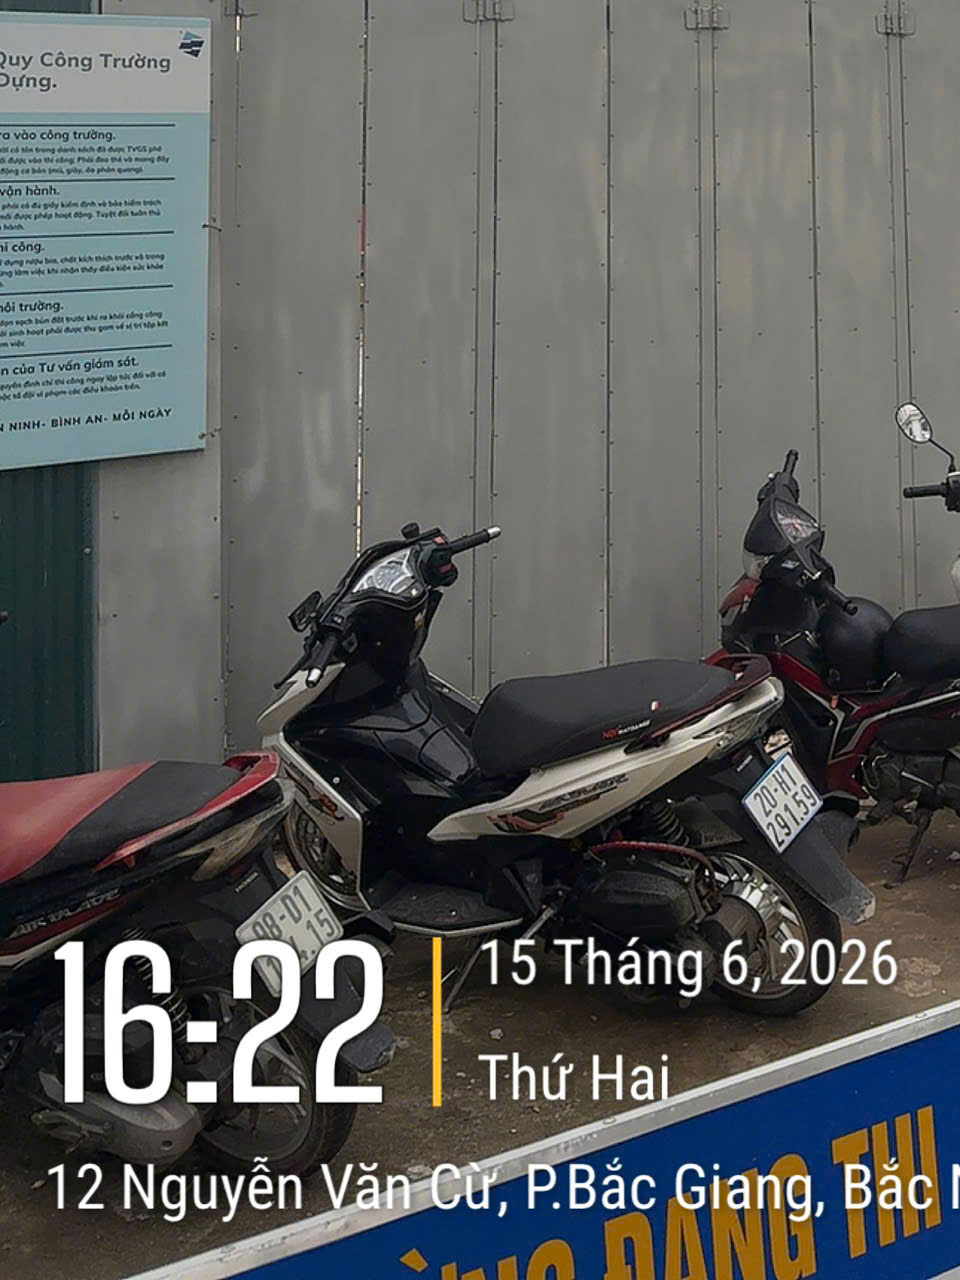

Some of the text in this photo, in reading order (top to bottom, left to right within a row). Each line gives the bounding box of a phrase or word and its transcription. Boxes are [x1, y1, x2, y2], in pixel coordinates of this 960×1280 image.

[40, 51, 92, 72] Công
[99, 53, 172, 74] Trường
[13, 129, 116, 142] vào công trường.
[26, 185, 60, 195] hành.
[12, 241, 45, 254] công.
[19, 300, 64, 313] trường.
[13, 363, 35, 375] của
[39, 362, 56, 373] Tư
[58, 360, 80, 371] vấn
[84, 358, 114, 372] giám
[117, 355, 139, 368] sát.
[9, 420, 46, 431] NINH-
[51, 415, 81, 428] BÌNH
[85, 414, 108, 424] AN-
[139, 407, 172, 420] NGÀY
[753, 763, 798, 818] 20-H1
[766, 783, 818, 848] 291.59
[831, 1105, 942, 1259] THI
